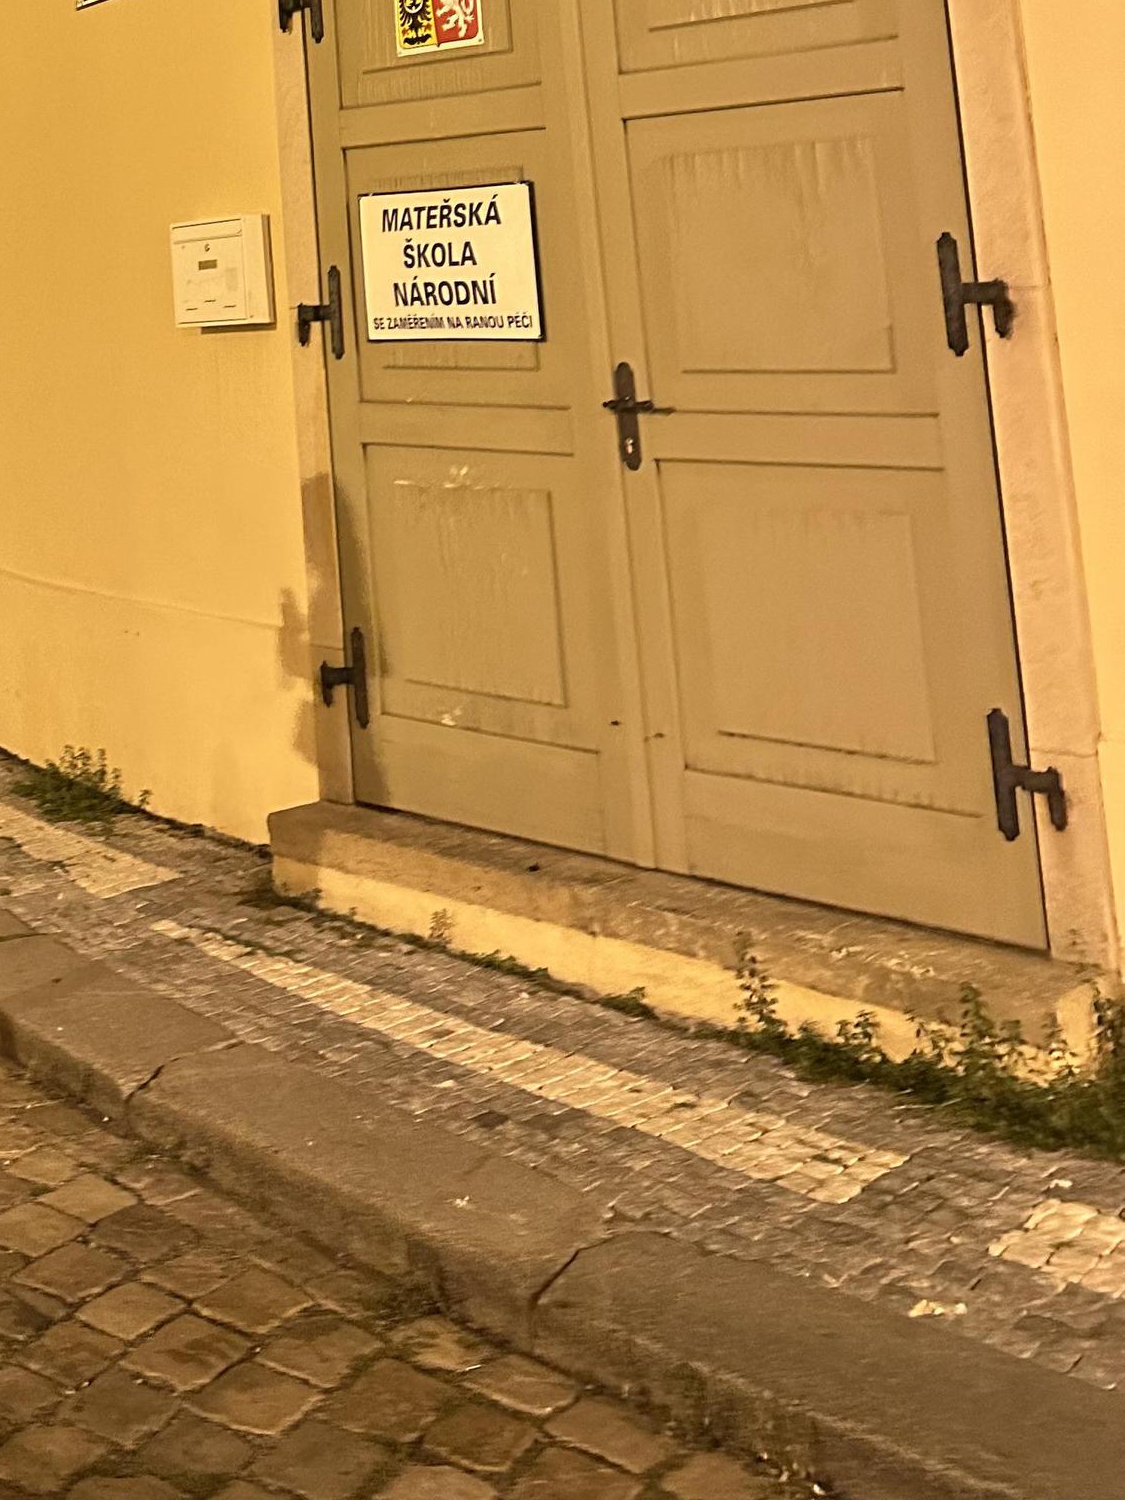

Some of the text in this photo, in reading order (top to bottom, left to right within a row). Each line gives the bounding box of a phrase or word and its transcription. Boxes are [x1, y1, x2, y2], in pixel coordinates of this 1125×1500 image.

[382, 194, 502, 233] MATEŘSKÁ
[403, 238, 477, 269] ŠKOLA
[393, 273, 497, 307] NÁRODNÍ
[373, 317, 385, 330] SE
[447, 316, 463, 329] NA
[465, 315, 504, 329] RANOU
[507, 311, 533, 328] PÉČI
